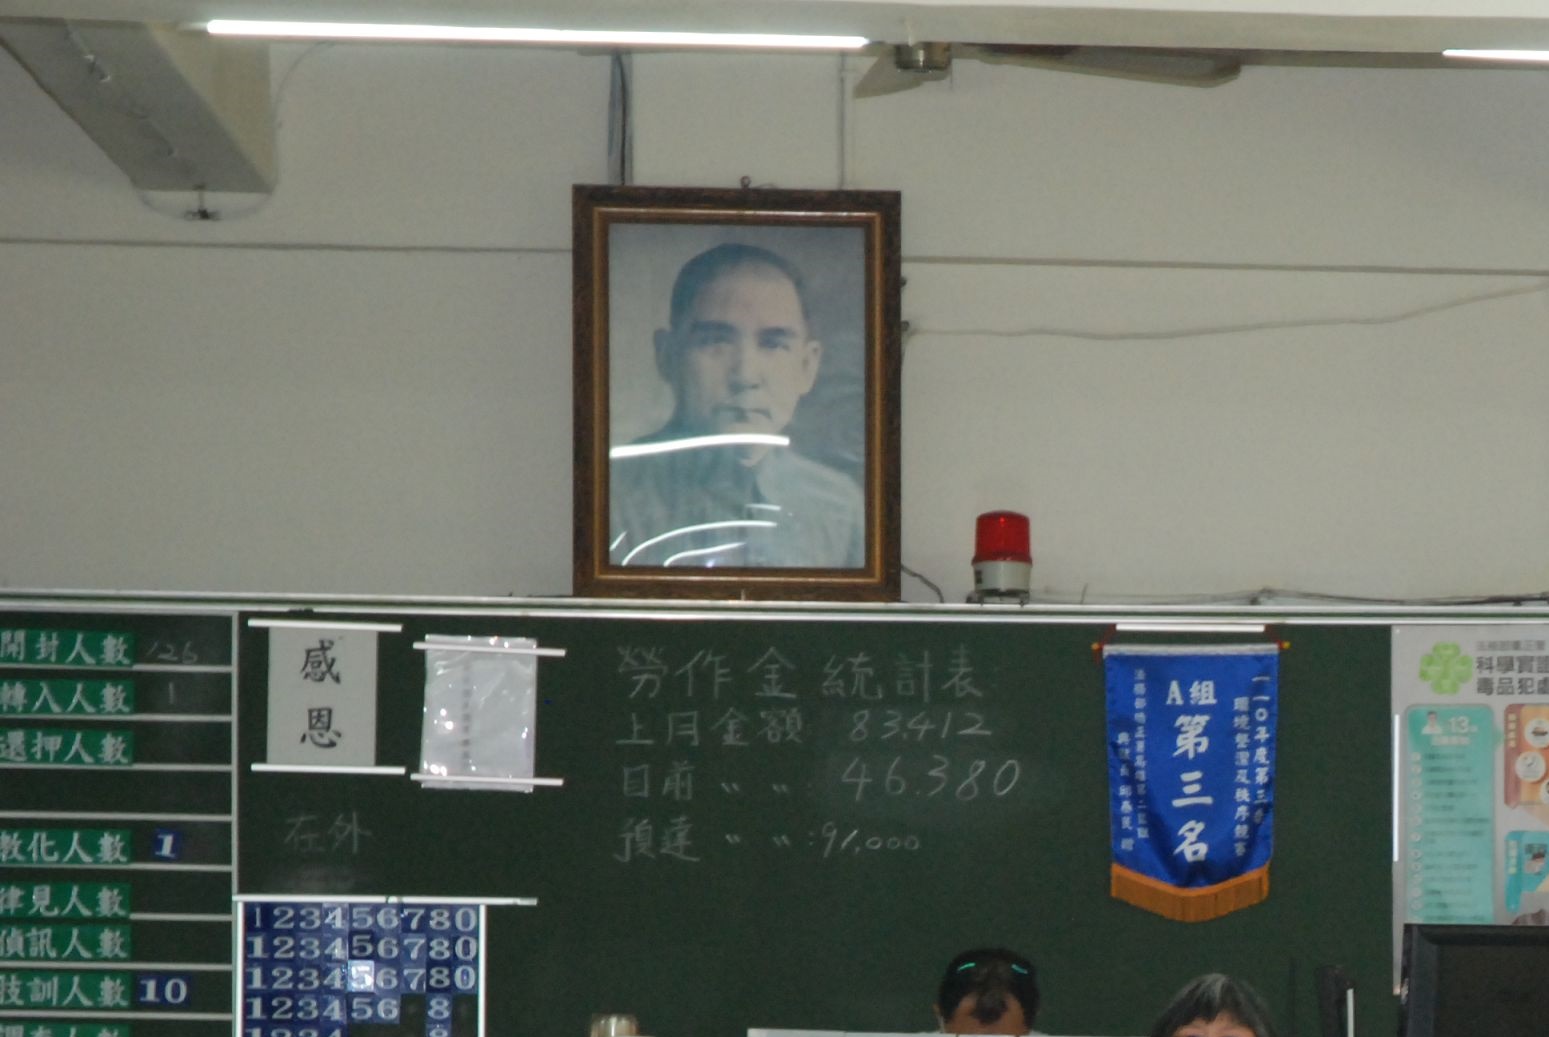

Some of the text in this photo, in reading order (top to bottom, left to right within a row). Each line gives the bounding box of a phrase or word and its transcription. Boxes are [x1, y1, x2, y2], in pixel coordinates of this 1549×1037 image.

[0, 630, 131, 666] 開封人數
[616, 644, 983, 702] 勞作金統計表
[0, 681, 131, 714] 轉入人數
[299, 640, 342, 749] 感恩
[614, 707, 803, 747] 上月金額
[622, 760, 695, 800] 目前
[1172, 714, 1214, 863] 第三名
[154, 834, 177, 859] 1
[140, 978, 188, 1004] 10
